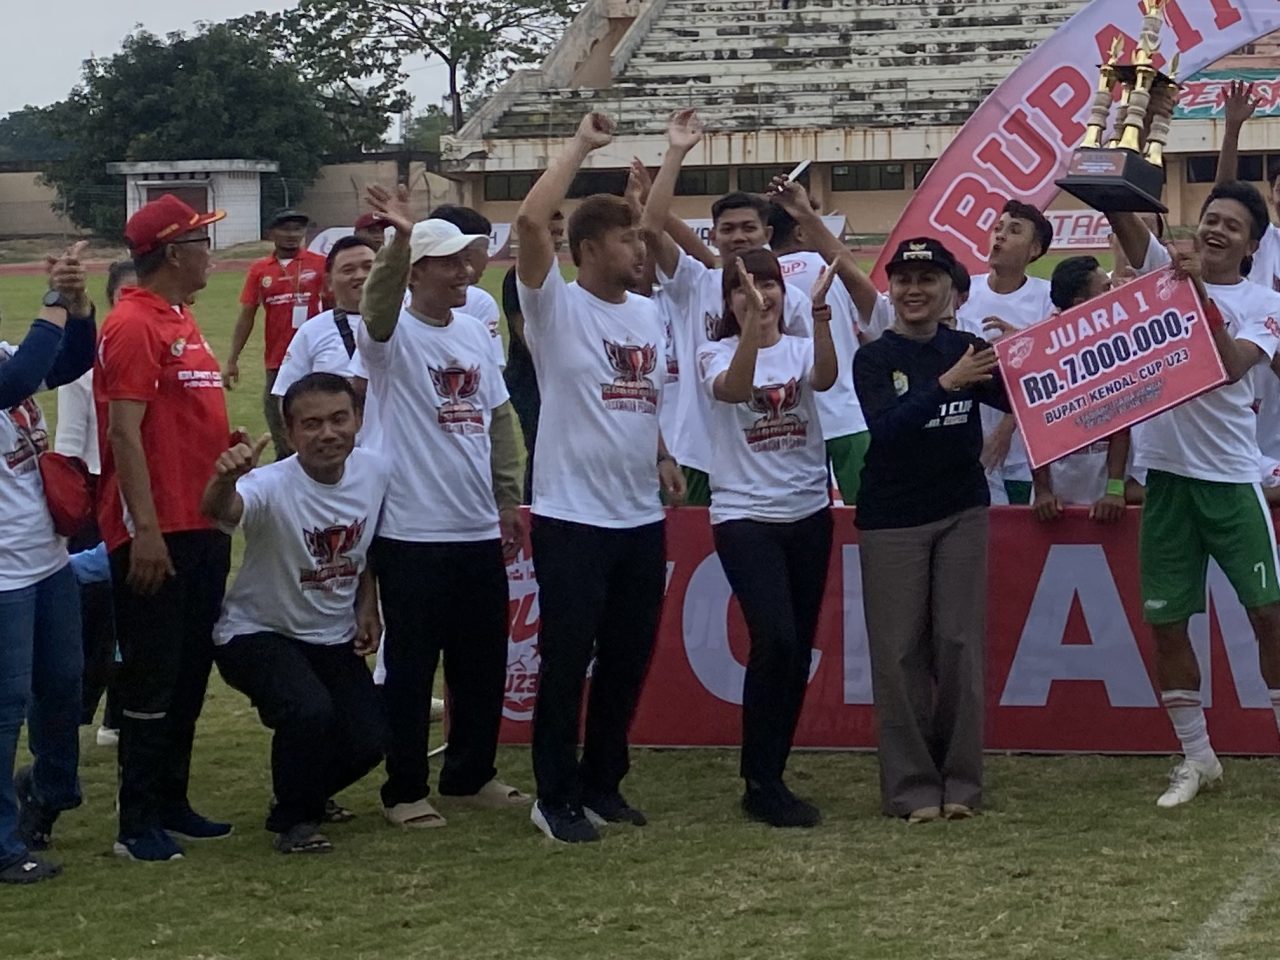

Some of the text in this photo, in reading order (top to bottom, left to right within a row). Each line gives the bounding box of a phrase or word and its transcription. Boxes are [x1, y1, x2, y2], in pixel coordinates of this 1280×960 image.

[1045, 301, 1129, 355] JUARA
[1133, 291, 1150, 313] 1
[1021, 370, 1065, 406] Rp.
[1045, 398, 1087, 425] BUPATI
[1089, 376, 1137, 403] KENDAL
[1138, 361, 1163, 381] CUP
[1165, 349, 1189, 368] U23
[1253, 561, 1267, 589] 7
